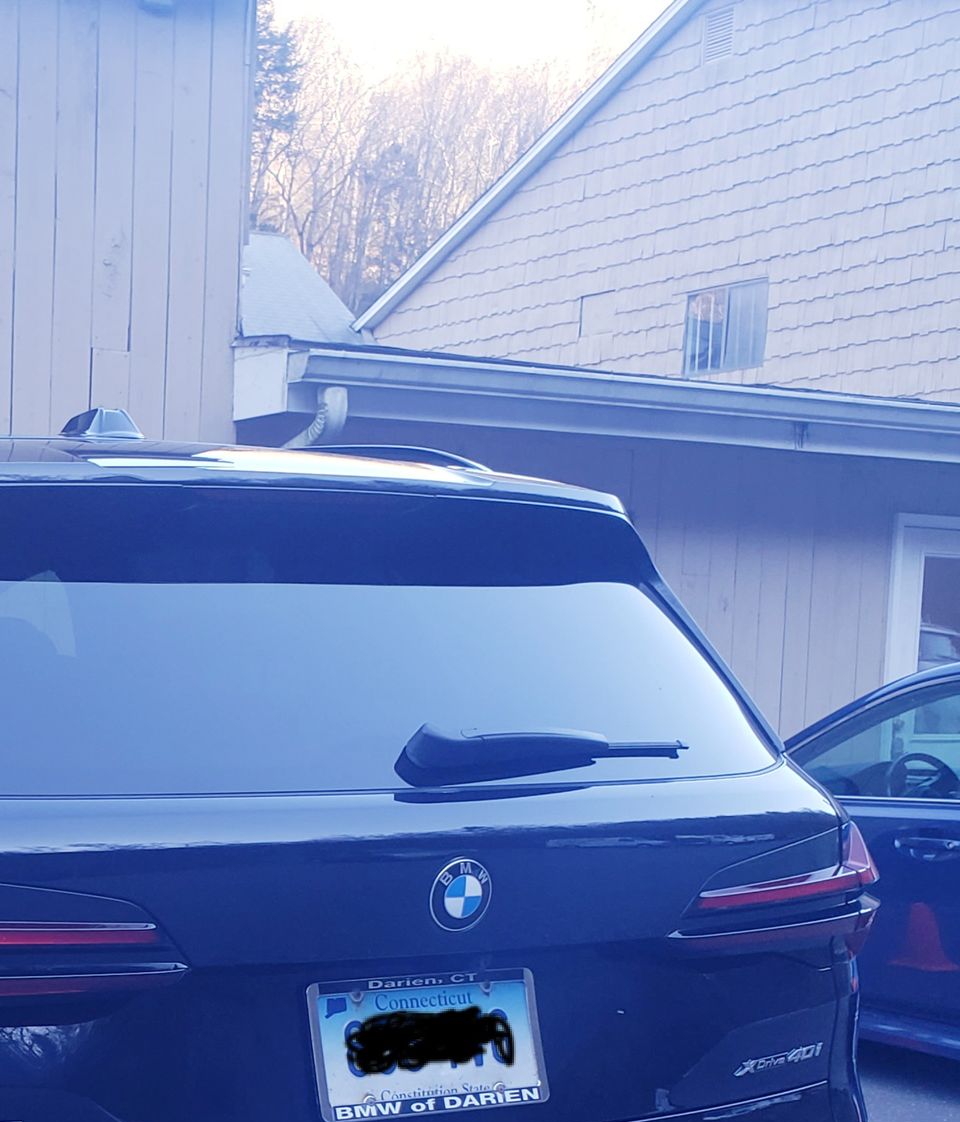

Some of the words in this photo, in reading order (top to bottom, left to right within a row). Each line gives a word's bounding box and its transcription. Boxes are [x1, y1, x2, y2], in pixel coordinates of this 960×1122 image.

[439, 862, 490, 887] BMW
[367, 975, 443, 990] Darien,
[450, 972, 479, 983] CT
[374, 991, 473, 1011] Connecticut
[335, 1101, 402, 1121] BMW
[411, 1098, 436, 1113] of
[444, 1087, 540, 1110] DARIEN
